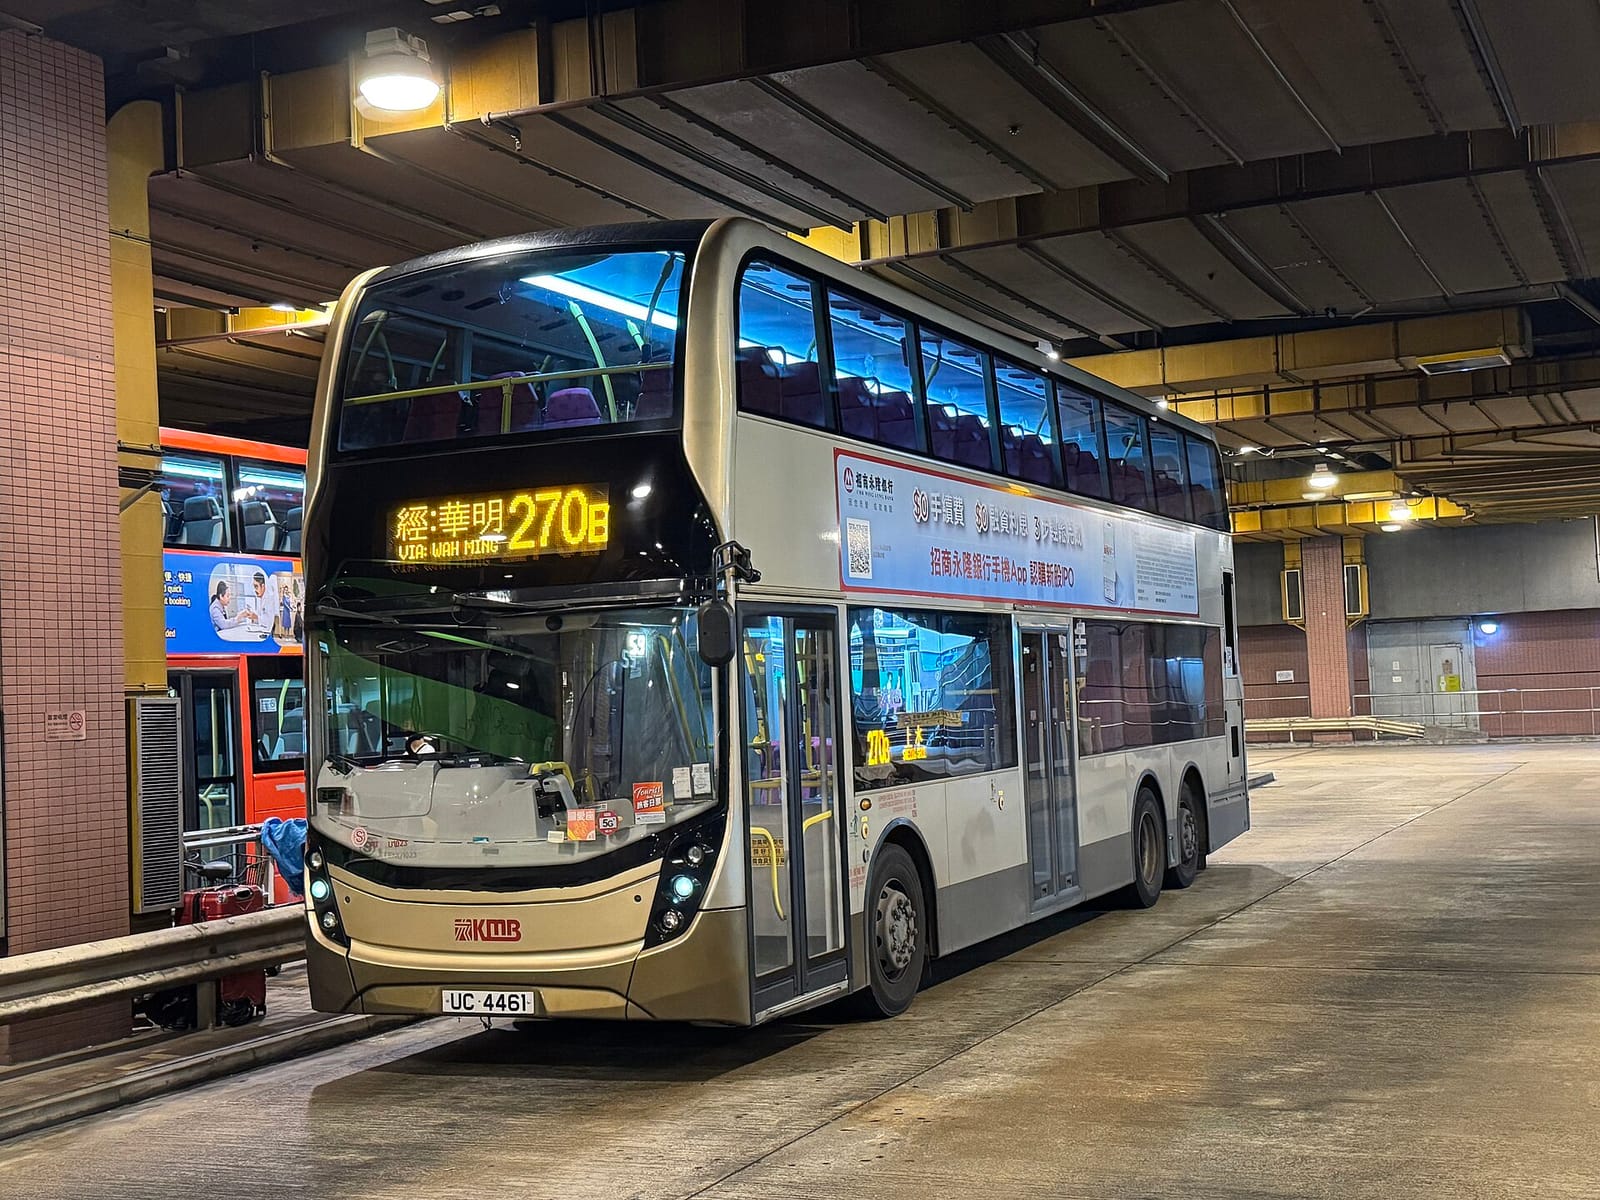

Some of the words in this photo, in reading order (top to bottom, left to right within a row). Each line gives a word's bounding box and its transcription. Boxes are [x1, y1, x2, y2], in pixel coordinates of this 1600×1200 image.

[509, 490, 610, 550] 270B
[431, 542, 460, 558] WAH
[464, 539, 498, 555] MING
[473, 919, 522, 942] KMB
[450, 993, 474, 1010] UC
[483, 994, 526, 1012] 4461
